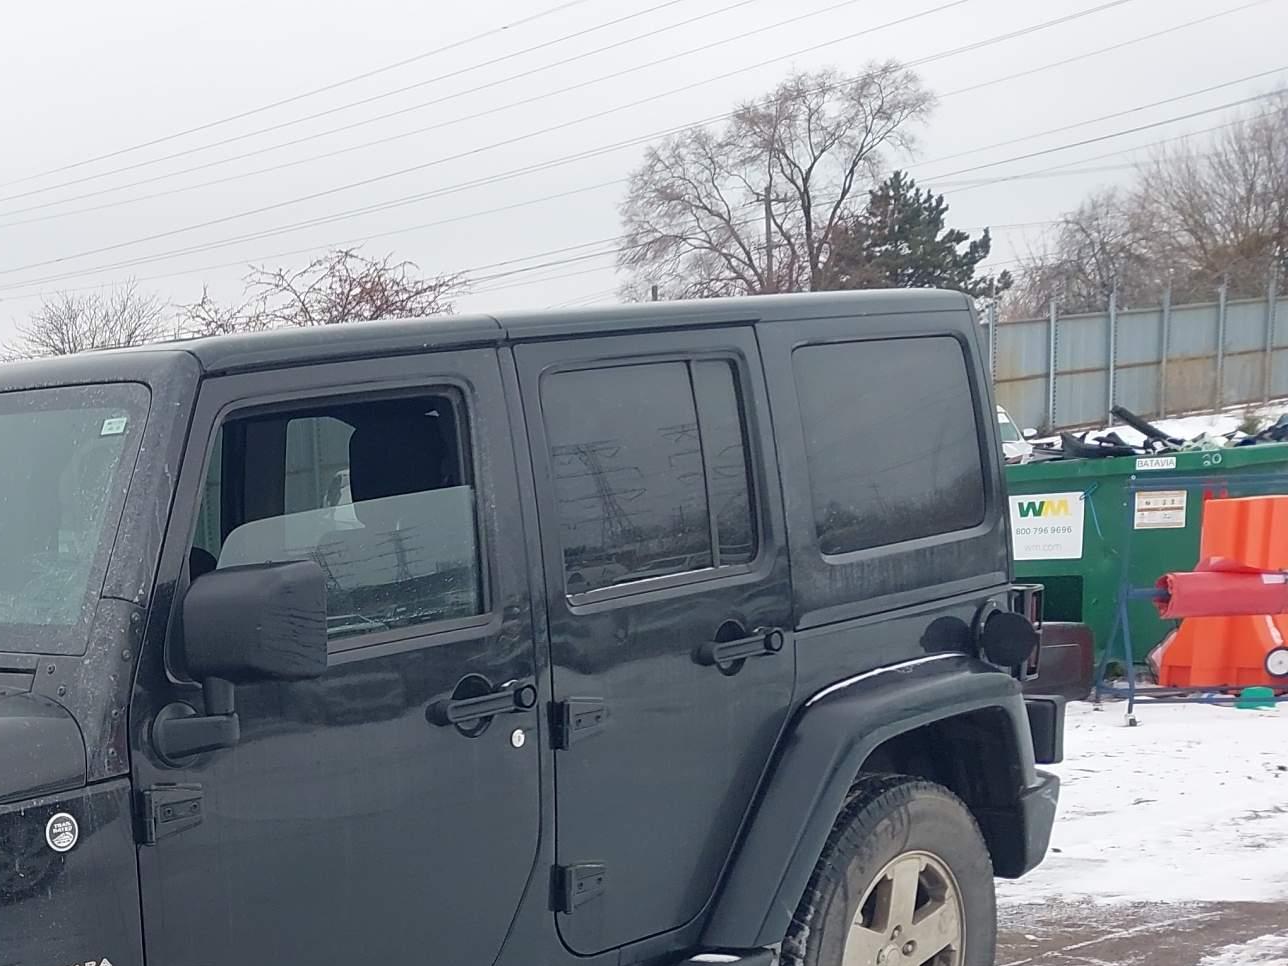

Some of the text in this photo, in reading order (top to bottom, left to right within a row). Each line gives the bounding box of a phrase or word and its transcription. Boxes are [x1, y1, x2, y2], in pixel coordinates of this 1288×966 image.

[1137, 459, 1175, 468] BATAVIA
[1018, 499, 1069, 517] WM
[1016, 527, 1031, 535] 800
[1024, 543, 1062, 551] wm.com
